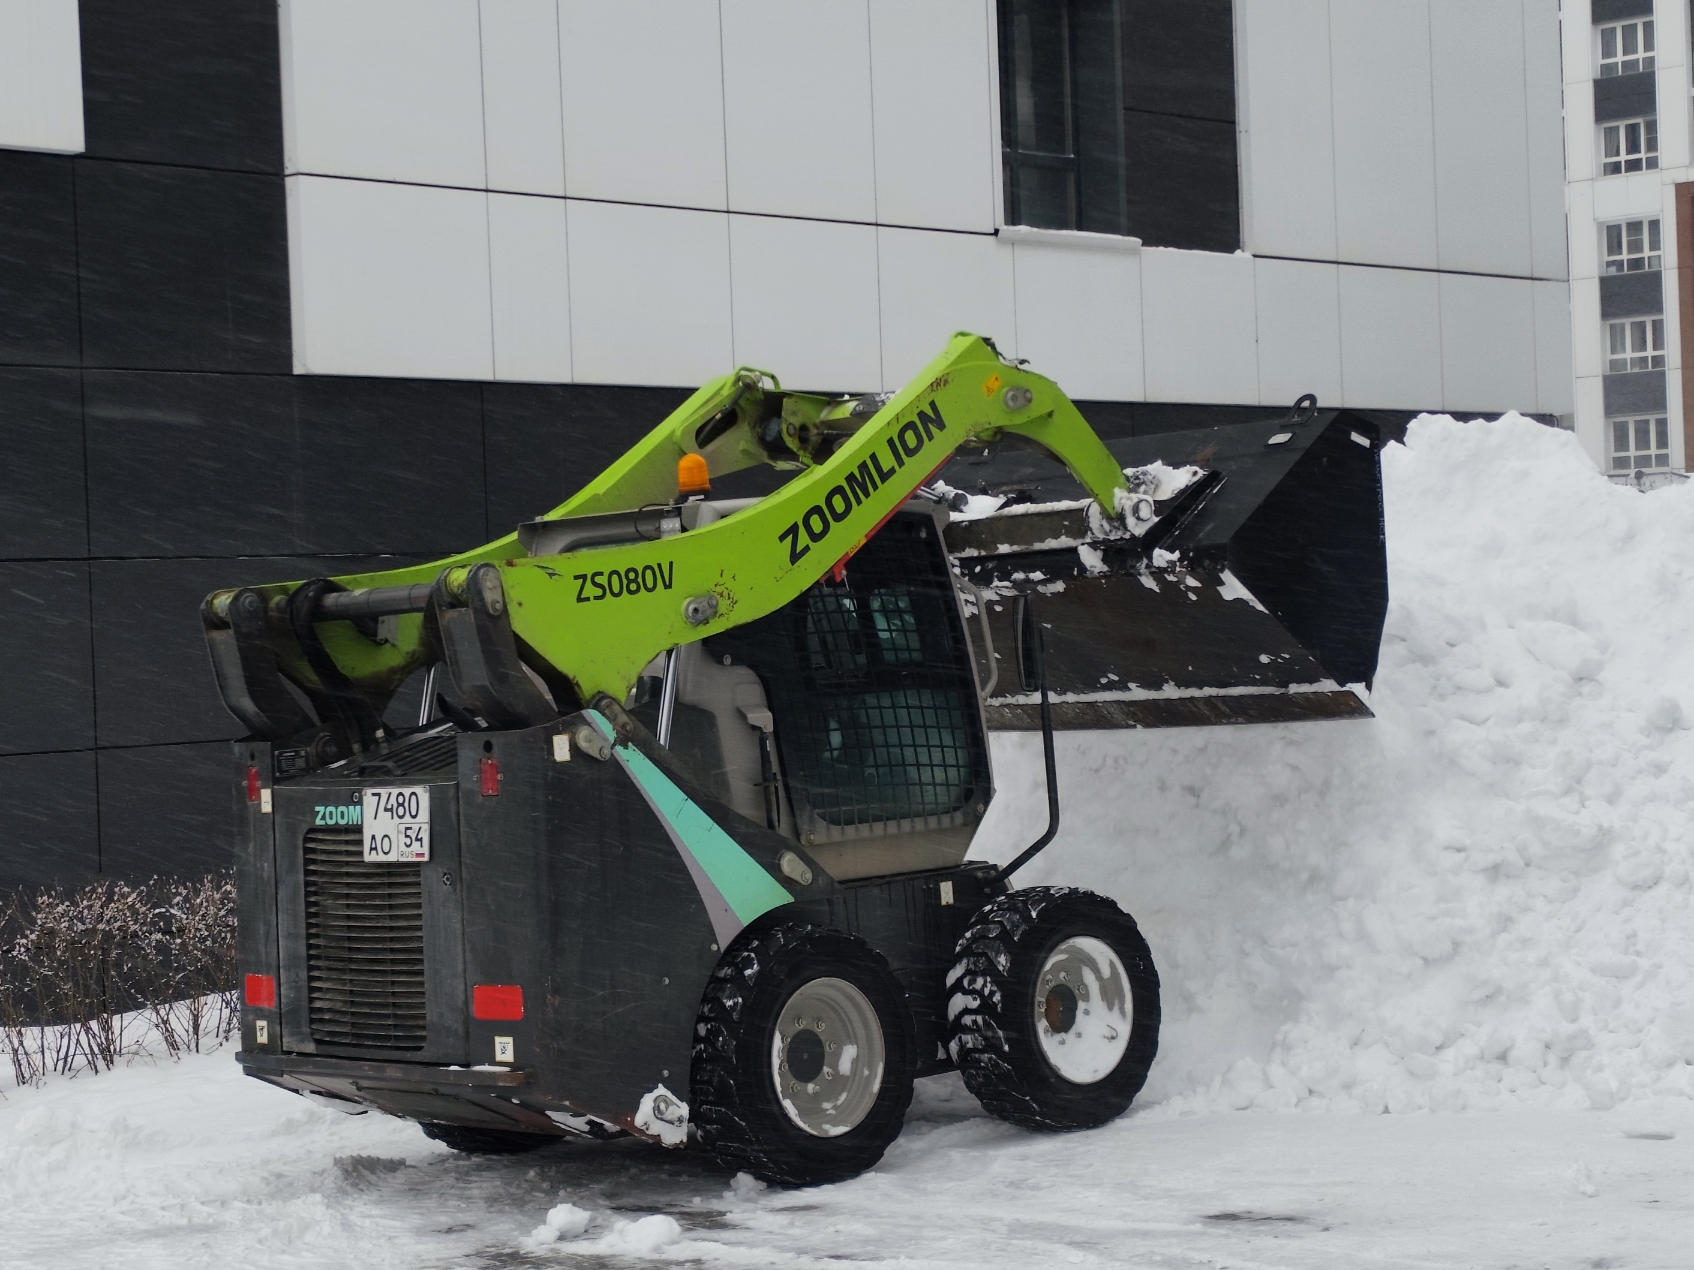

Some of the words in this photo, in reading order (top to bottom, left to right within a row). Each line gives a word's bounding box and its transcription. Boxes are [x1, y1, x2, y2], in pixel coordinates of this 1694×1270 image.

[778, 400, 947, 567] ZOOMLION
[573, 561, 674, 604] ZS080V
[314, 805, 363, 825] ZOOM
[371, 791, 419, 820] 7480
[404, 826, 423, 848] 54
[400, 850, 414, 858] RUS
